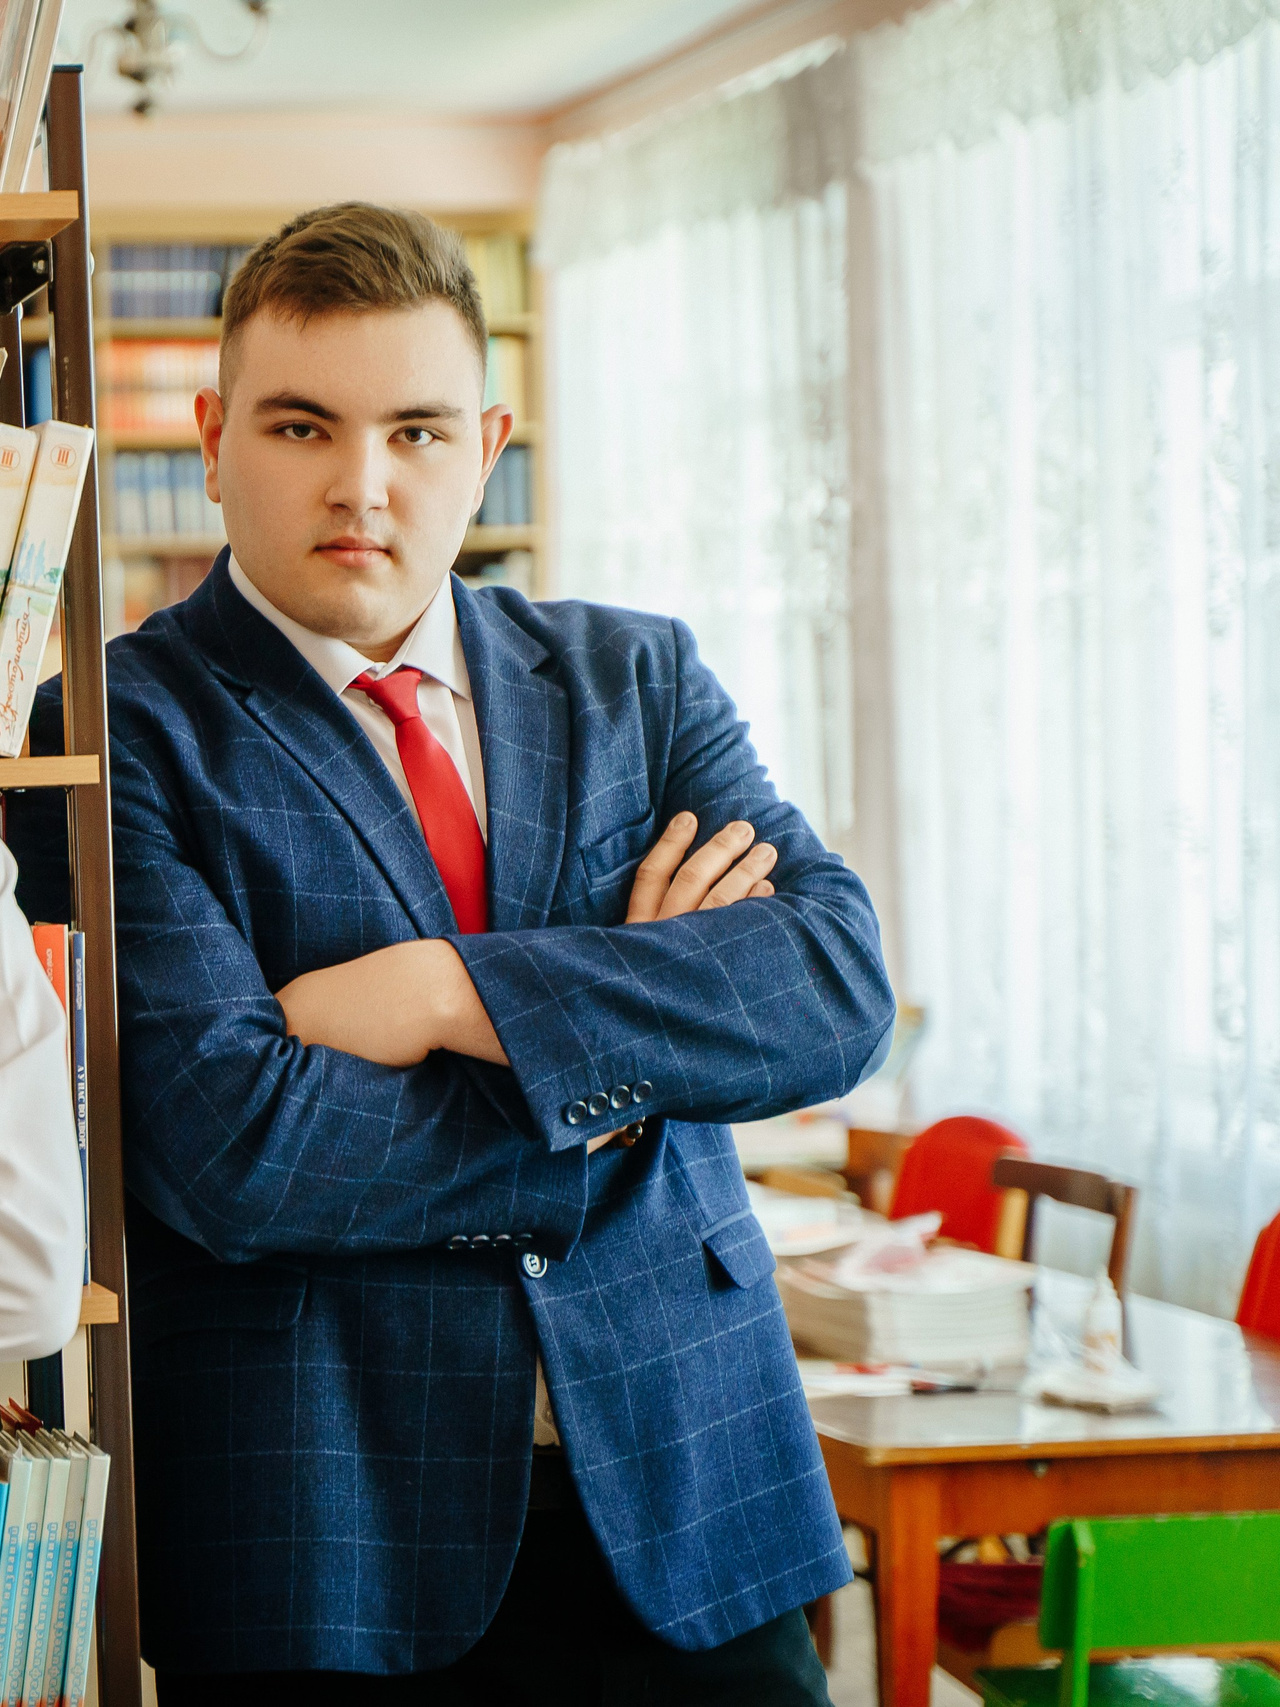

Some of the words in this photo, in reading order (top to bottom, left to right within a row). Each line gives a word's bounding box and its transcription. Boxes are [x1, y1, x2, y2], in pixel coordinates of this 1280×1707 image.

[9, 1601, 27, 1707] графических
[28, 1601, 47, 1707] графических
[47, 1600, 66, 1707] графических
[71, 1600, 89, 1707] графических
